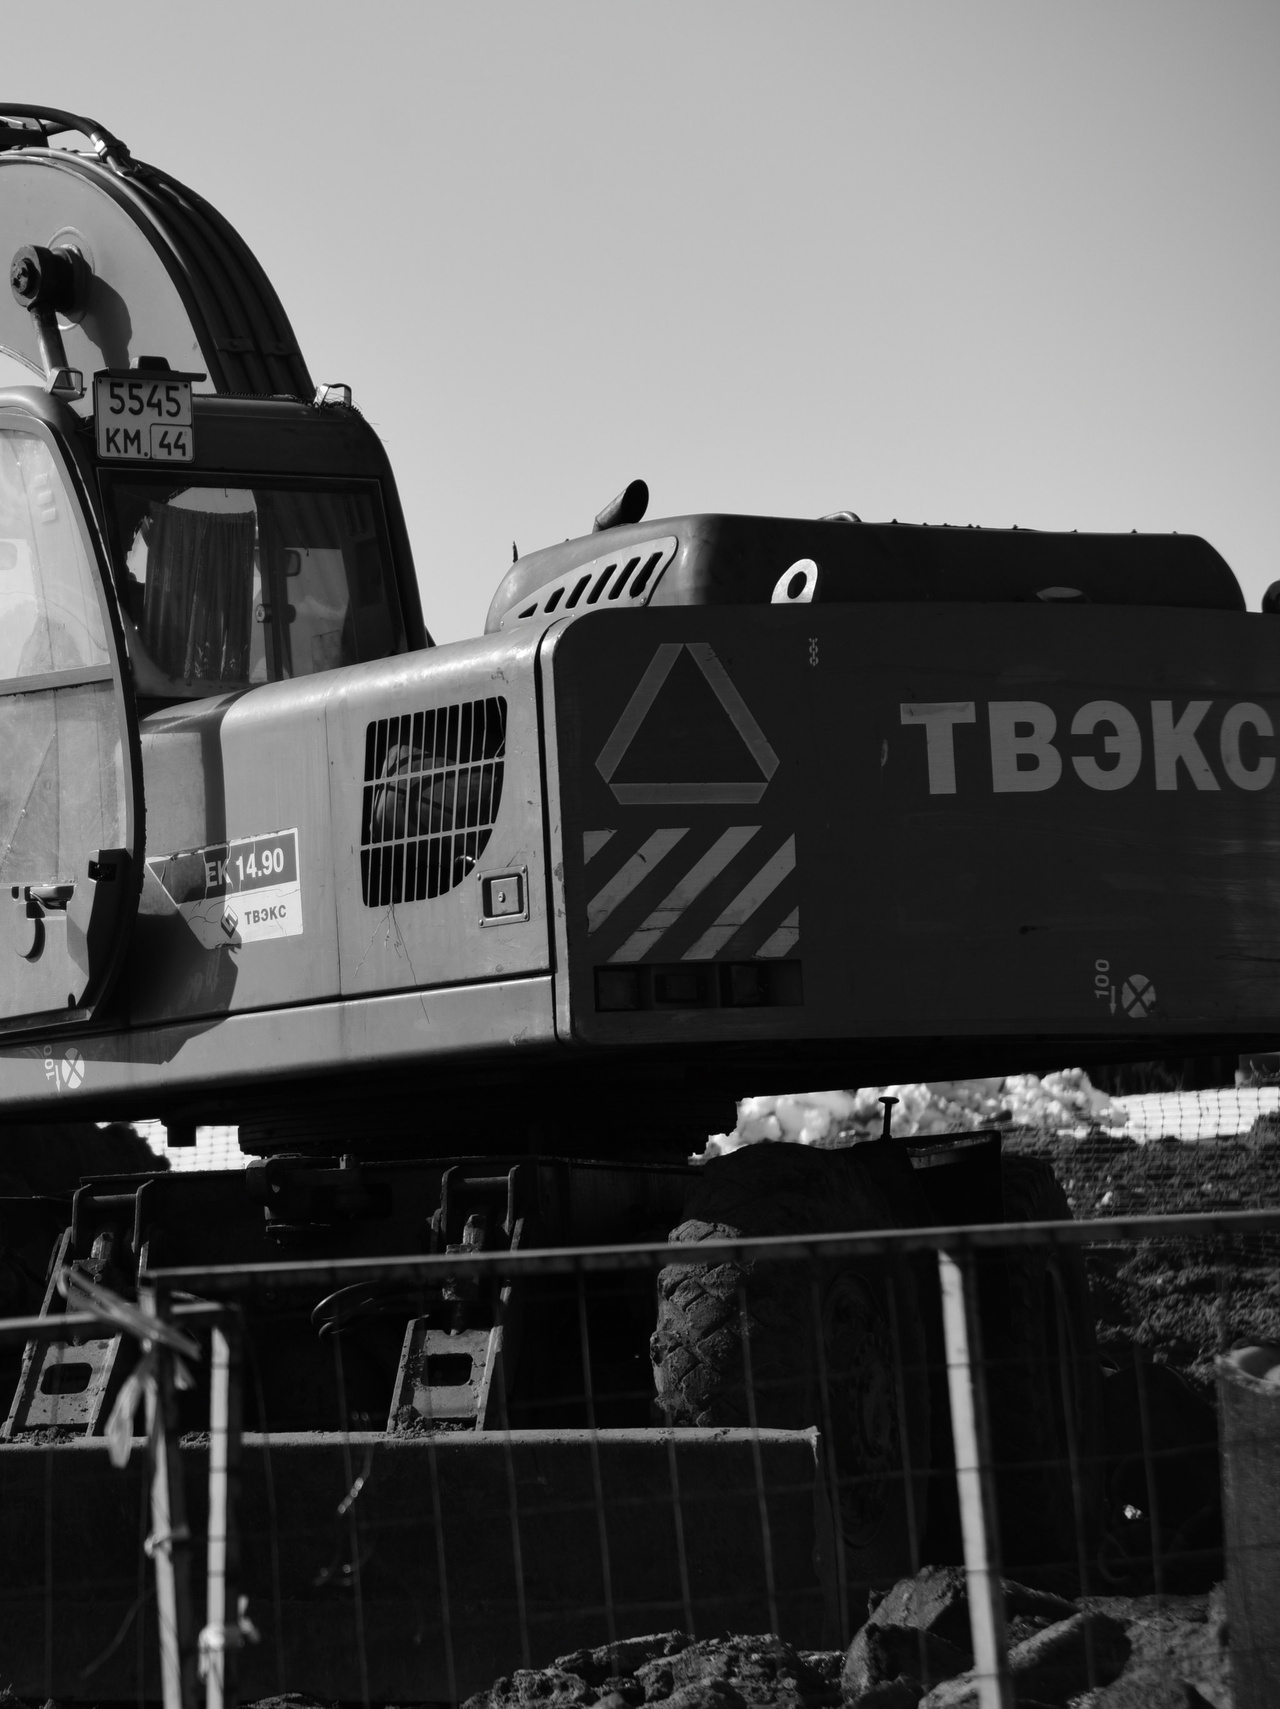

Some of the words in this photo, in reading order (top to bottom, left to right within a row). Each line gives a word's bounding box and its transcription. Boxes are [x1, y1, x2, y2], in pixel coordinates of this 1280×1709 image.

[109, 382, 182, 418] 5545
[158, 430, 187, 457] 44
[899, 699, 1278, 795] ТВЭКС
[235, 847, 285, 881] 14.90
[244, 904, 287, 926] ТВЭКС
[1093, 958, 1110, 999] 100
[43, 1044, 55, 1080] 100
